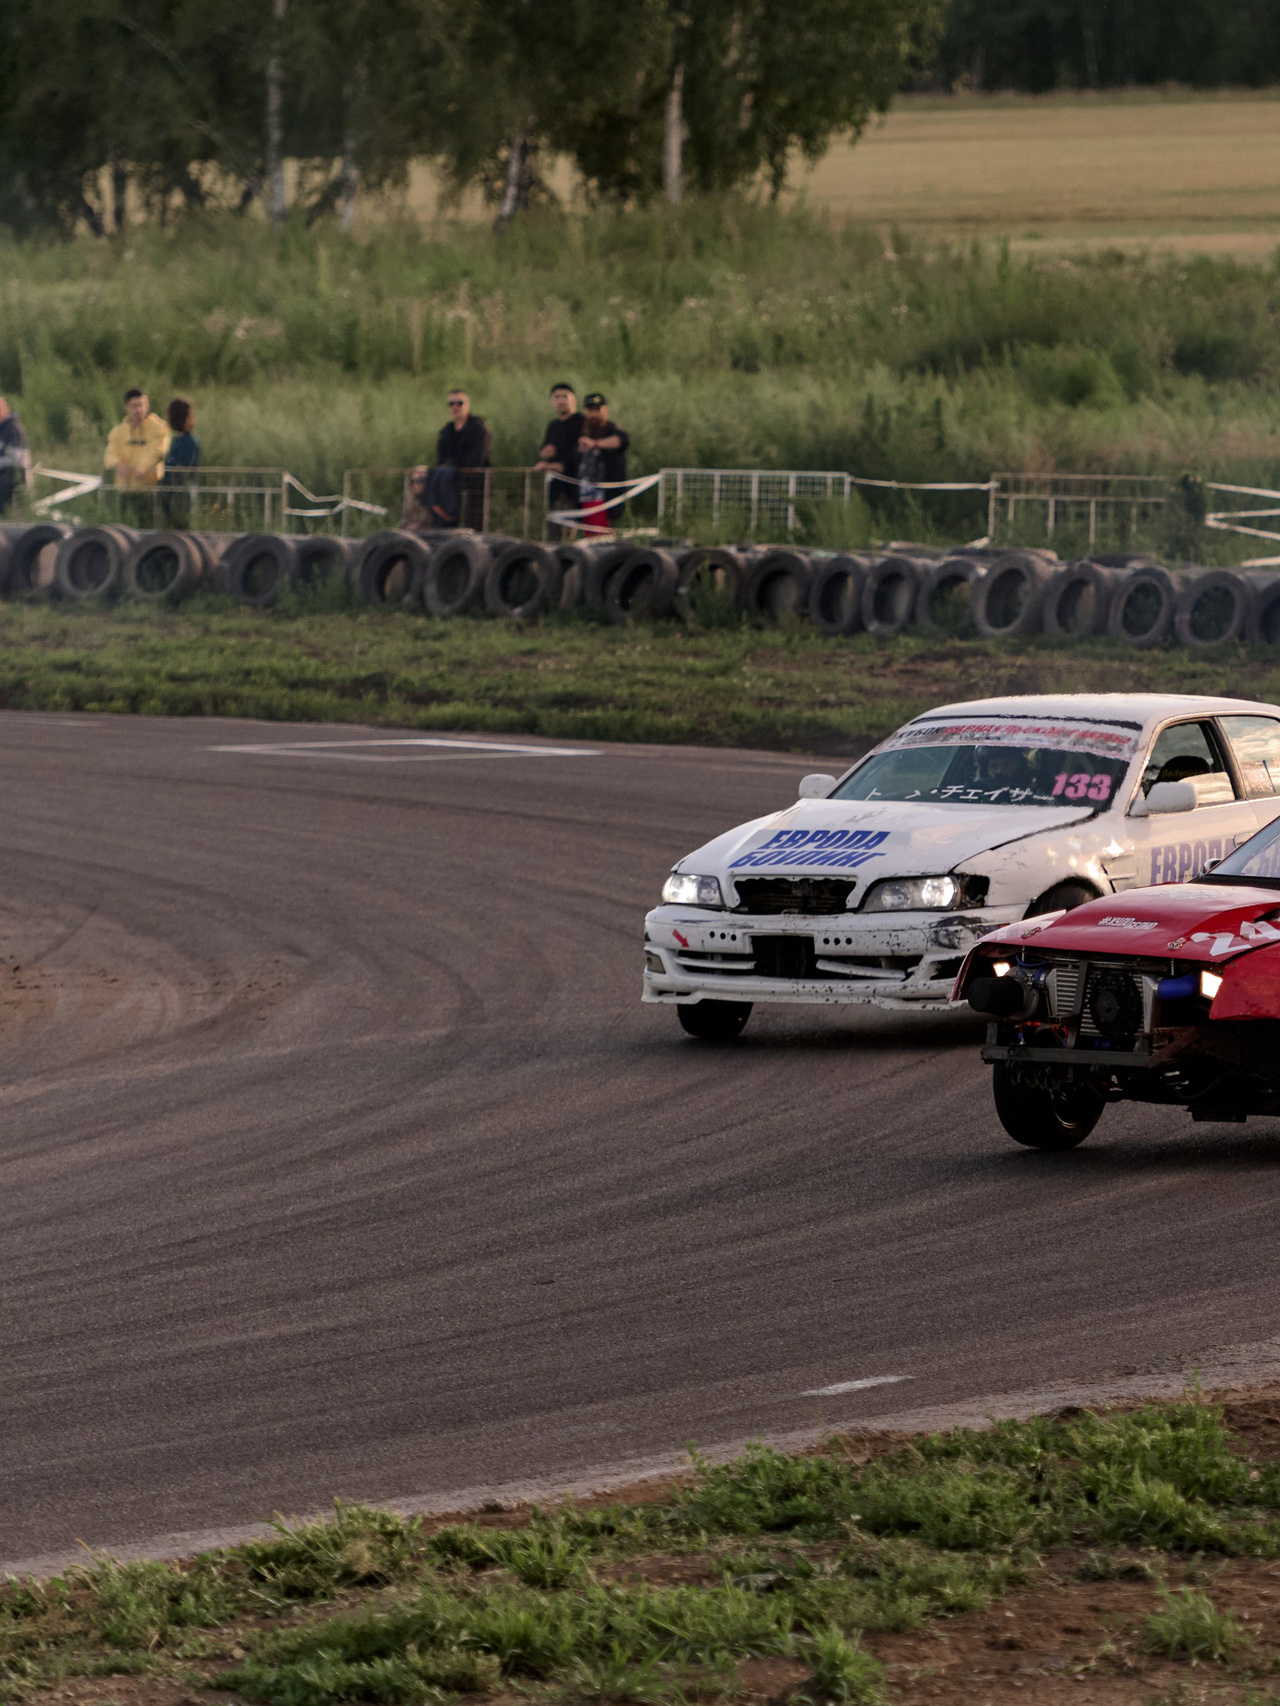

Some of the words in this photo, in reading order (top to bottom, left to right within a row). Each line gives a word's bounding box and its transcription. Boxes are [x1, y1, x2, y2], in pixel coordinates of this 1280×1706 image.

[1052, 773, 1112, 800] 133
[757, 829, 891, 850] ЕВРОПА
[727, 850, 888, 869] БОУЛИНГ
